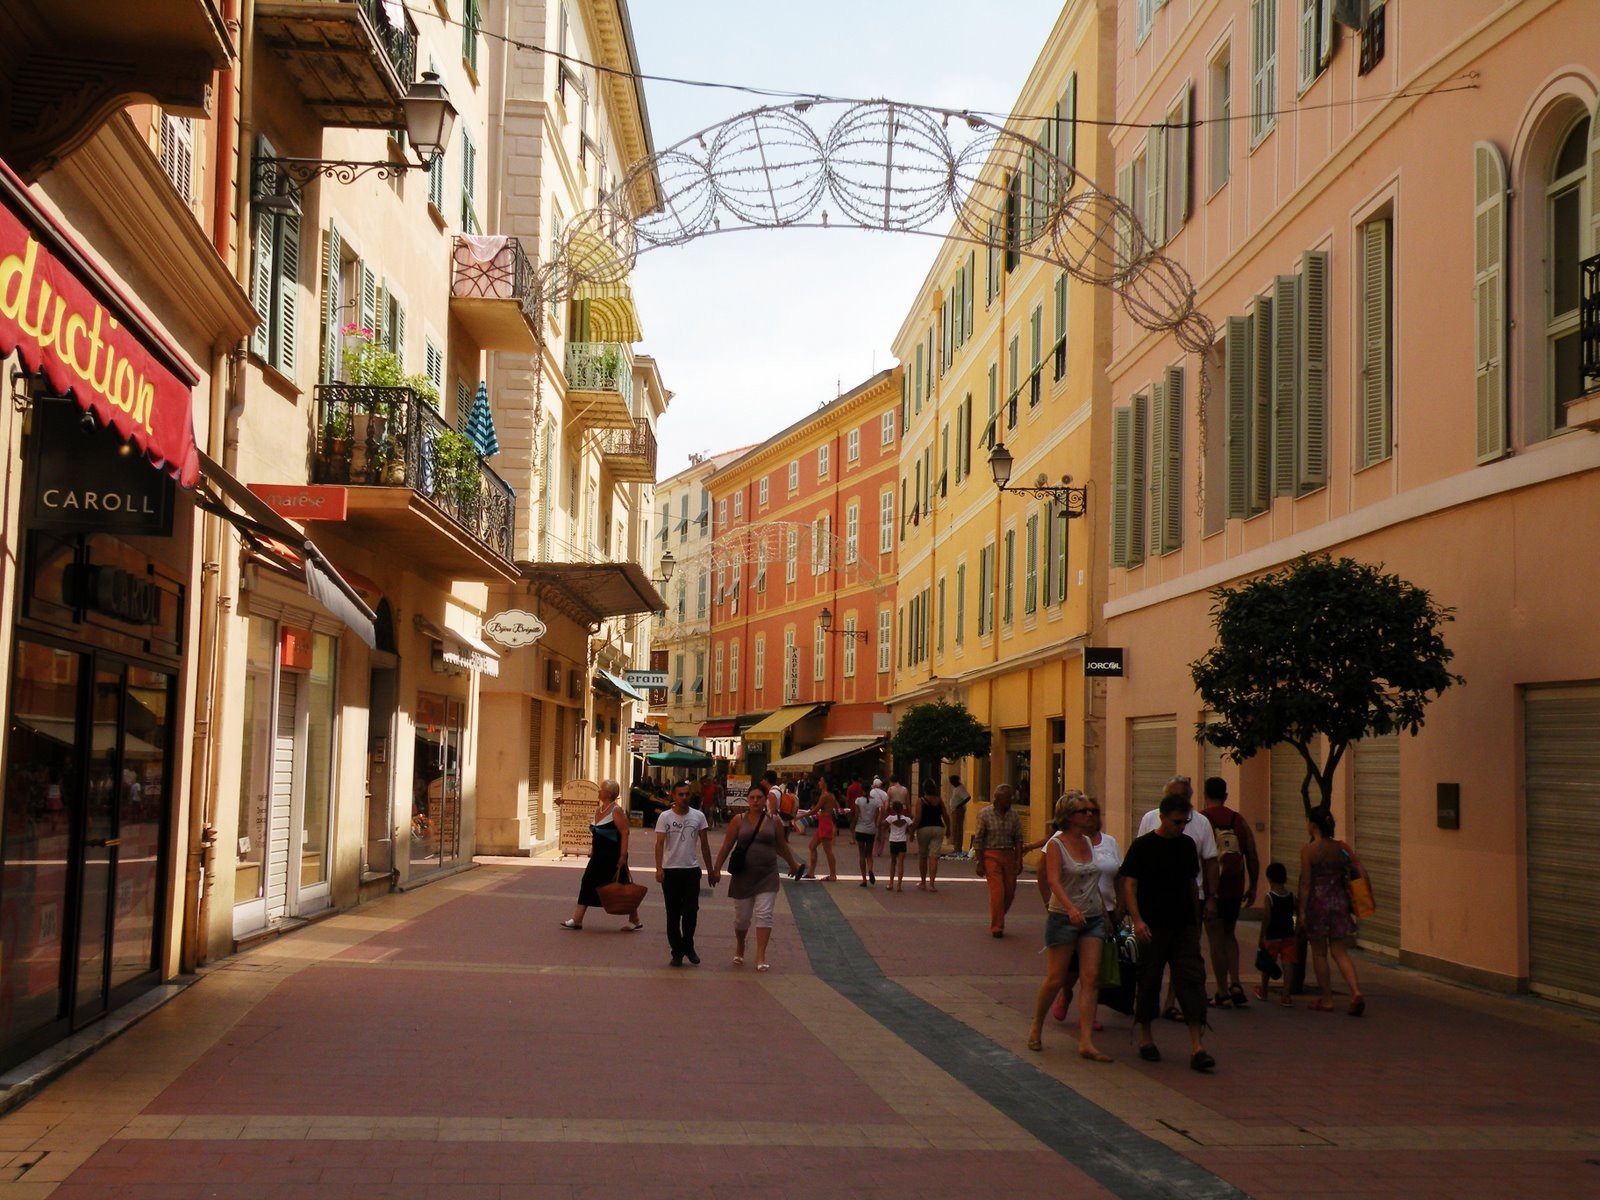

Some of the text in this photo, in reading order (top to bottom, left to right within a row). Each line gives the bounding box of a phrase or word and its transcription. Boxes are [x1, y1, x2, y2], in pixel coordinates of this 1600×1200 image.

[0, 234, 154, 436] duction
[43, 489, 155, 513] CAROLL
[627, 675, 664, 683] eram
